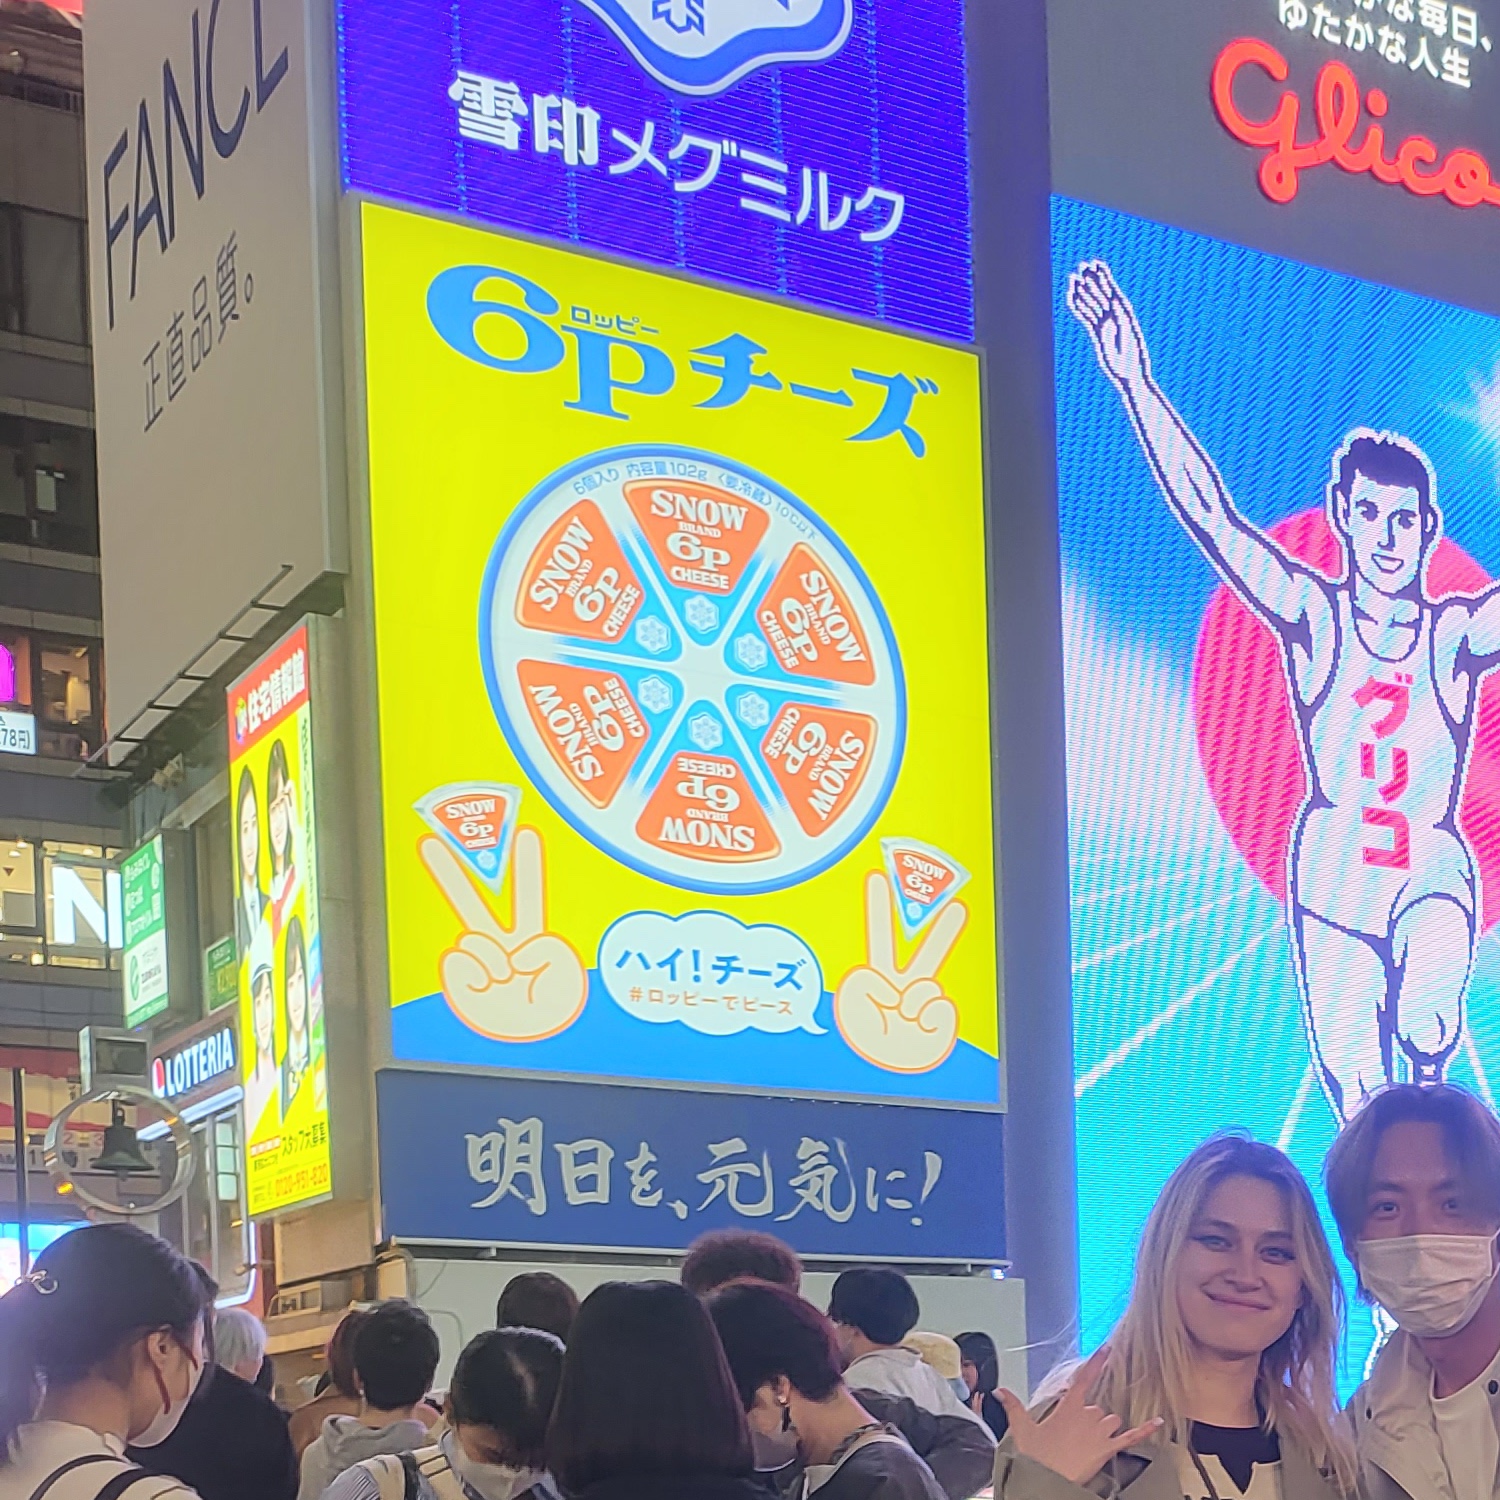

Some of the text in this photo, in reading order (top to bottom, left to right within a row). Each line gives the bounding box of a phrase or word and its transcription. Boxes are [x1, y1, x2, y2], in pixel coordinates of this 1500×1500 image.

[1277, 0, 1472, 89] ゆたかな人生
[447, 70, 905, 243] 雪印メグミルク
[142, 229, 254, 433] 正直品質。
[571, 305, 660, 336] ロッピー
[651, 489, 749, 532] SNOW
[530, 516, 594, 613] SNOW
[666, 532, 731, 571] 6P
[670, 565, 729, 589] CHEESE
[573, 567, 622, 622] 6P
[602, 584, 641, 637] CHEESE
[799, 570, 867, 664] SNOW
[760, 610, 799, 669] CHEESE
[780, 597, 818, 662] 6P
[528, 684, 604, 782] SNOW
[583, 685, 624, 751] 6P
[603, 677, 645, 738] CHEESE
[764, 707, 800, 760] CHEESE
[677, 757, 736, 779] CHEESE
[783, 721, 827, 775] 6P
[807, 730, 865, 821] SNOW
[1352, 671, 1415, 870] グリコ
[676, 775, 740, 812] 6P
[659, 816, 755, 852] SNOW
[164, 1028, 235, 1096] LOTTERIA
